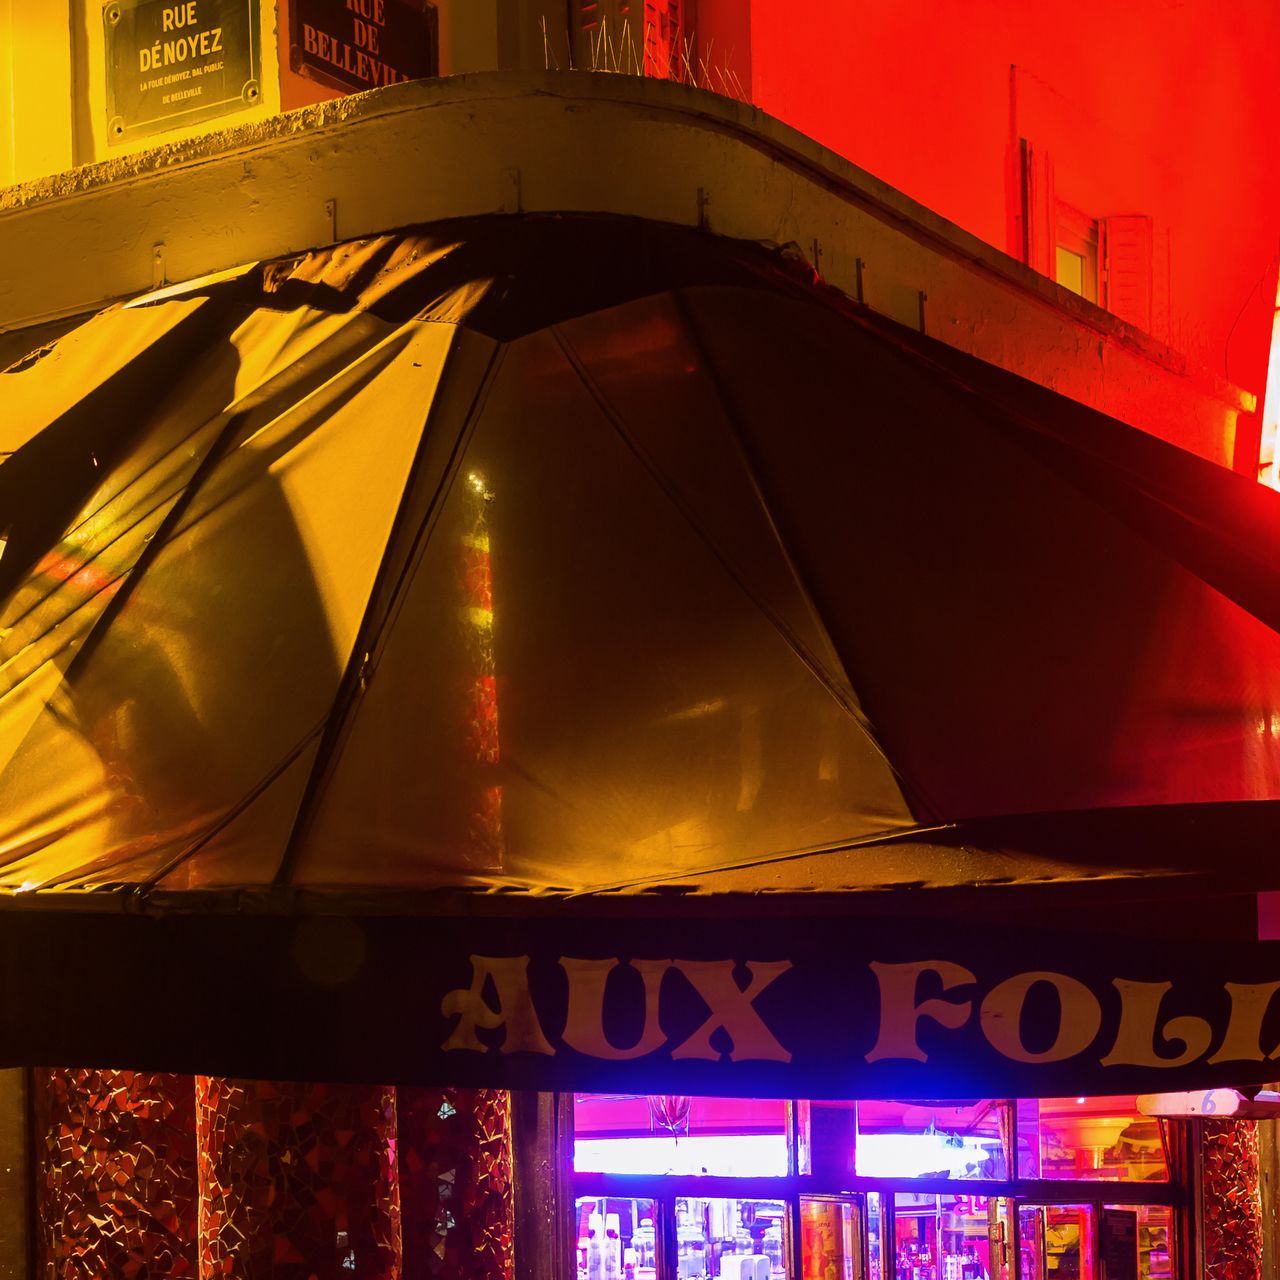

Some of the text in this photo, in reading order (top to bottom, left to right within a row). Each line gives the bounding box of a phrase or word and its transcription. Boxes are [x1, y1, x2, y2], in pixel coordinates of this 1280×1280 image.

[162, 1, 197, 32] RUE
[140, 28, 222, 72] DÉNOYEZ
[353, 18, 379, 55] DE
[140, 80, 148, 92] LA
[148, 78, 163, 90] FOLIE
[203, 61, 224, 74] PUBLIC
[162, 86, 202, 104] DE BELLEVILLE
[441, 954, 793, 1064] AUX
